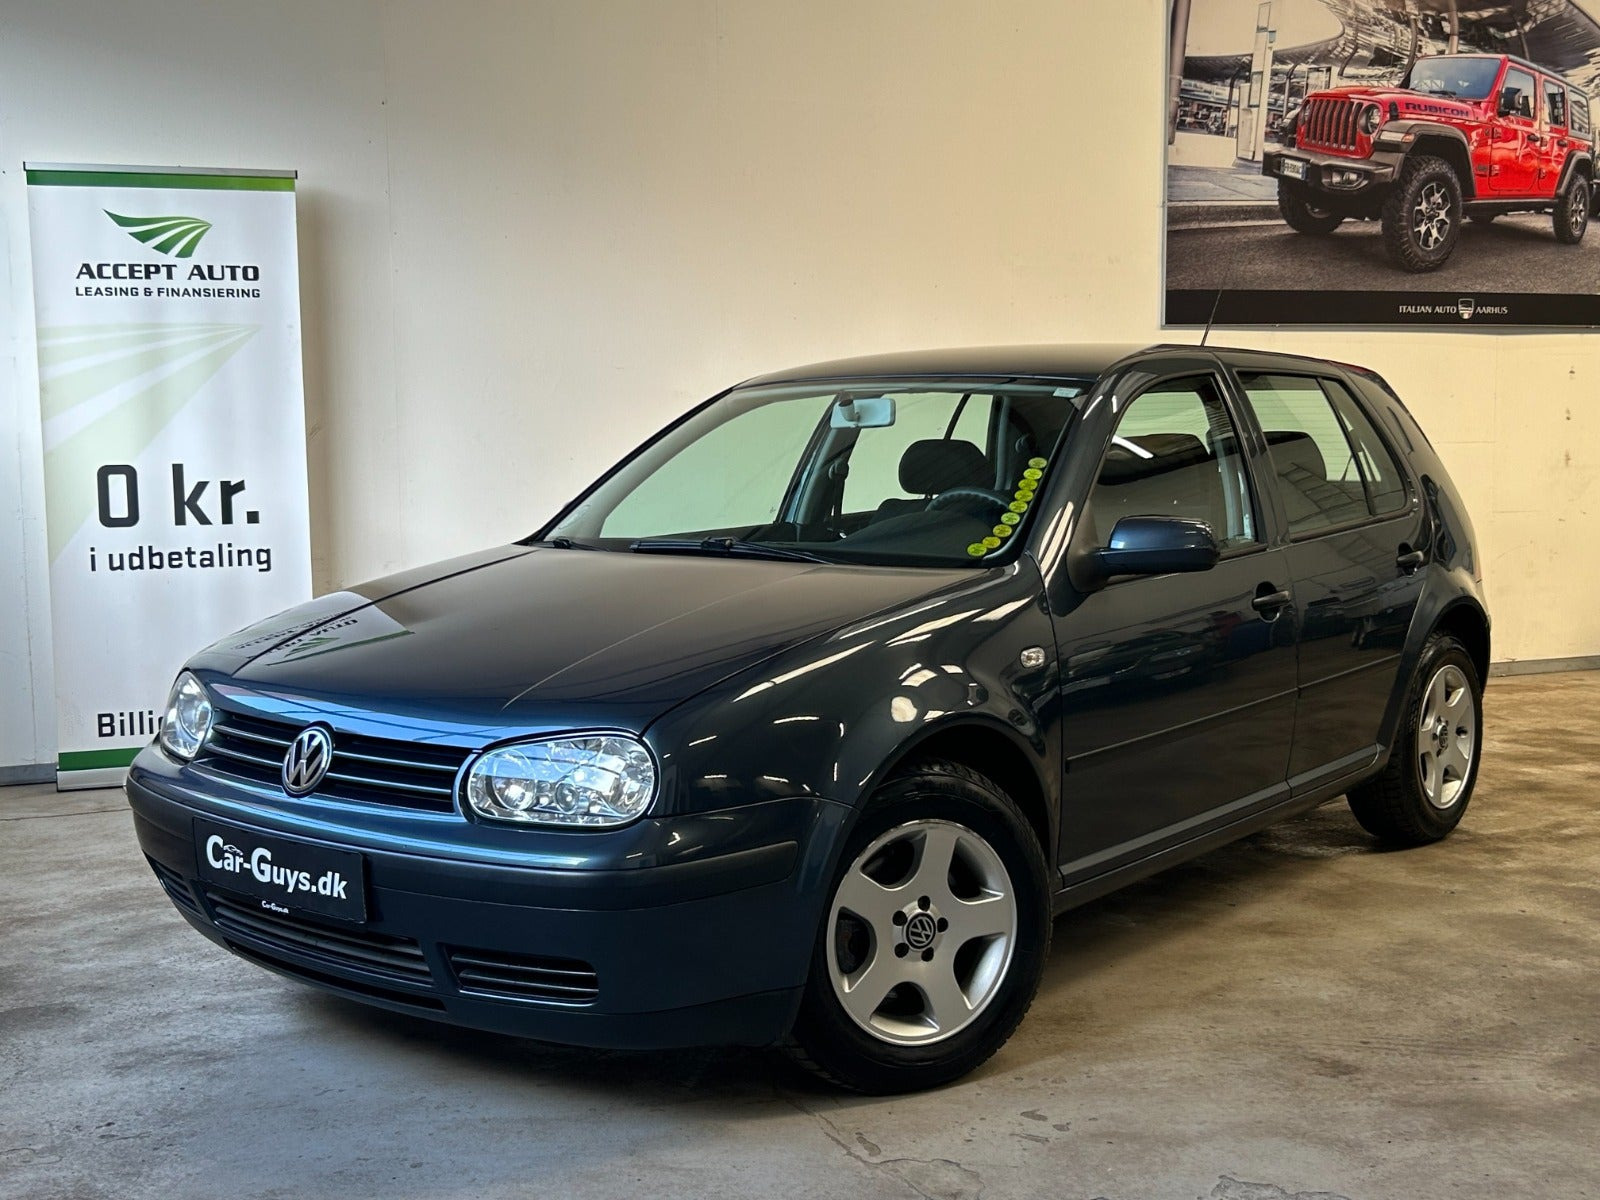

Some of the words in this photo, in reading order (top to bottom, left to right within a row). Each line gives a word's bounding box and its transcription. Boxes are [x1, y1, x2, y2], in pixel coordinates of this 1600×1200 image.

[1405, 102, 1469, 117] RUBICON
[76, 262, 177, 280] ACCEPT
[187, 264, 260, 281] AUTO
[75, 286, 139, 297] LEASING
[144, 287, 153, 297] &
[157, 287, 261, 298] FINANSIERING
[1399, 305, 1432, 314] ITALIAN
[1433, 305, 1457, 314] AUTO
[1475, 306, 1508, 315] AARHUS
[96, 464, 140, 528] 0
[172, 463, 260, 526] kr.
[90, 547, 97, 572] i
[108, 543, 272, 573] udbetaling
[206, 834, 348, 900] Car-Guys.dk
